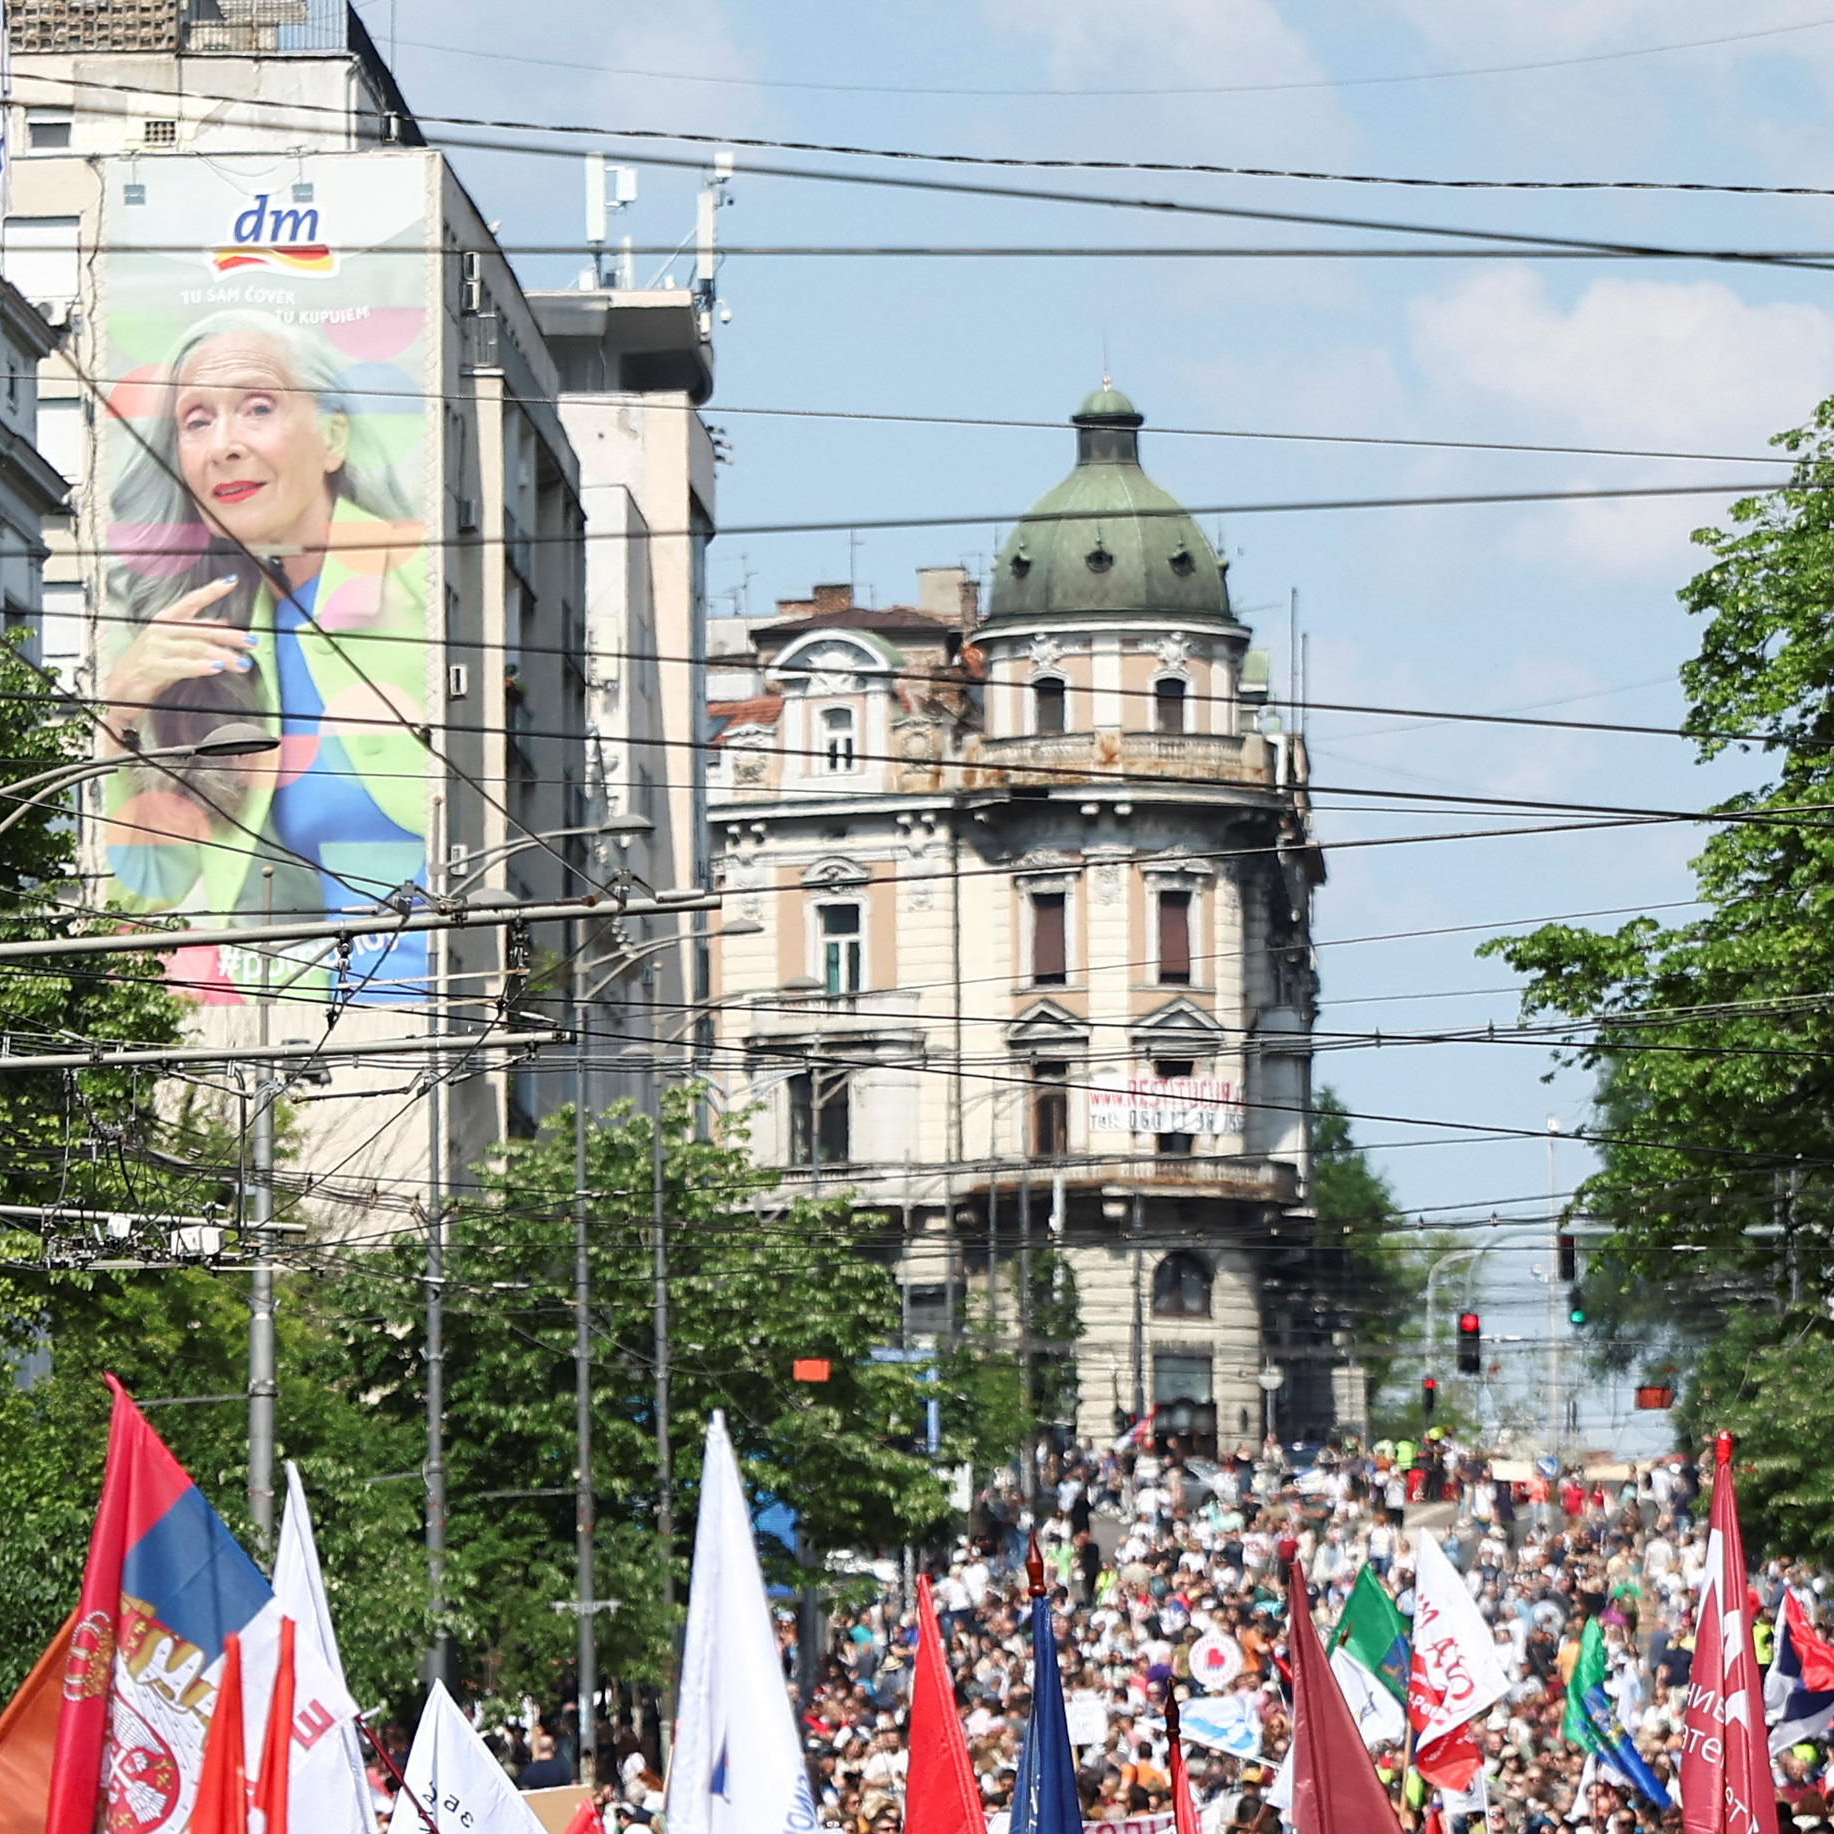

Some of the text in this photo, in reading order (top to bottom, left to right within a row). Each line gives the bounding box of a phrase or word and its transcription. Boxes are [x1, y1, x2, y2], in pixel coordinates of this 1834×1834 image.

[234, 194, 319, 243] dm
[181, 289, 202, 305] TU
[244, 284, 297, 306] ČOVEK
[276, 305, 371, 326] TU KUPUJEM
